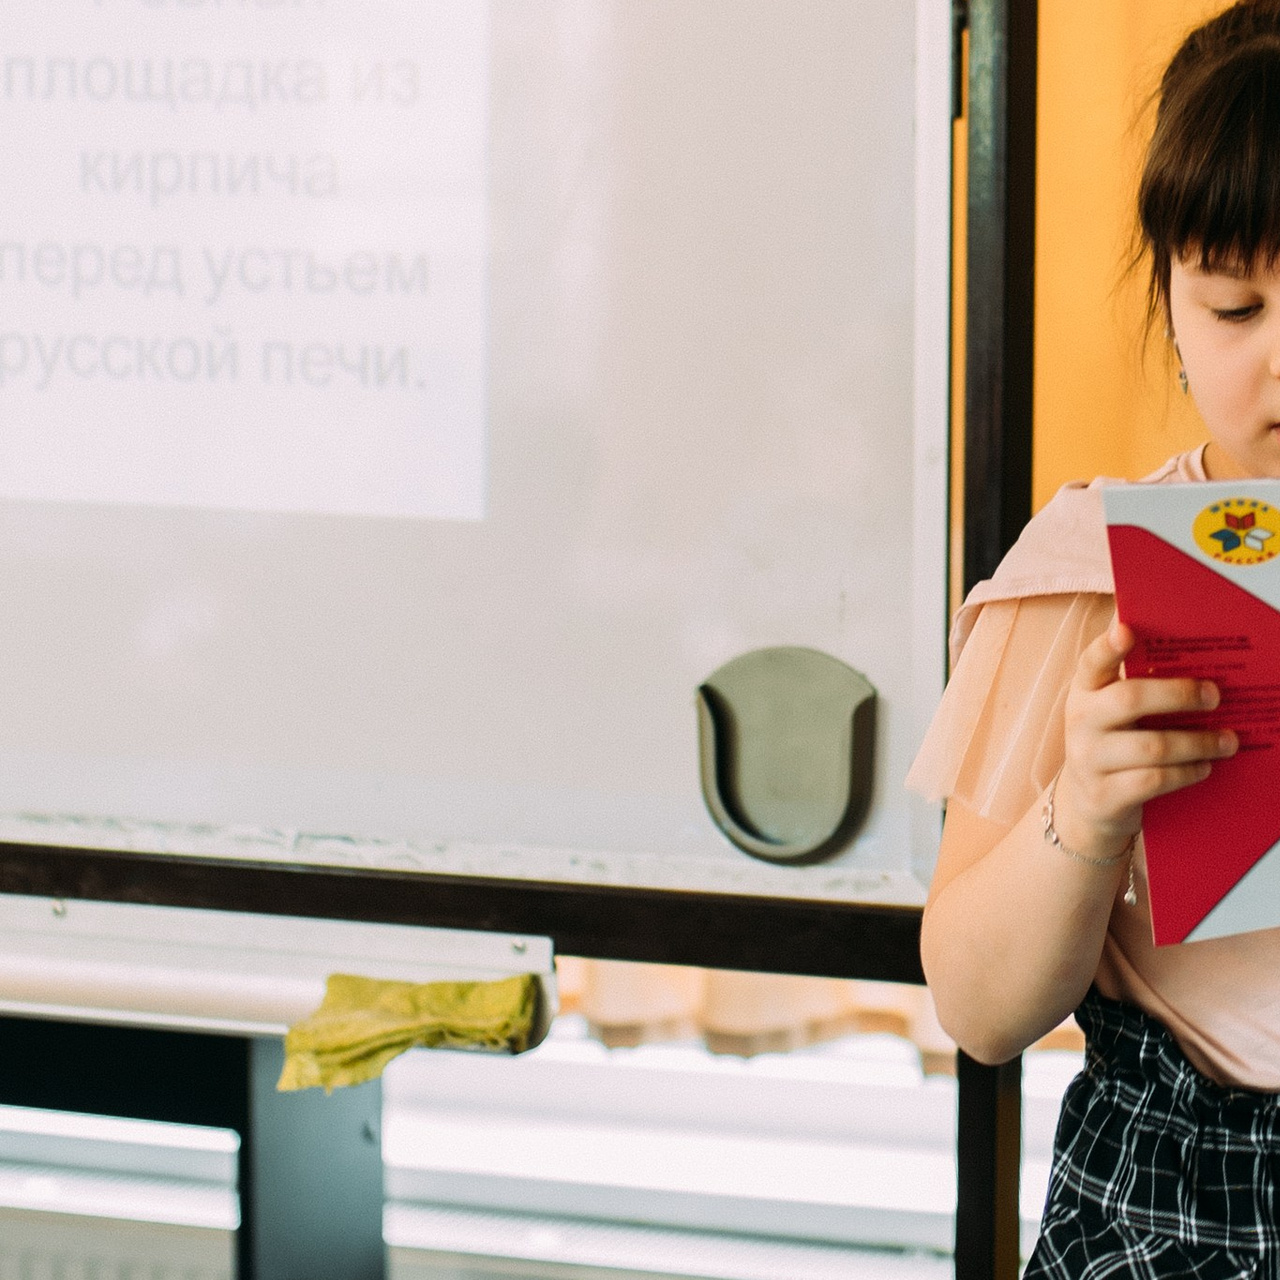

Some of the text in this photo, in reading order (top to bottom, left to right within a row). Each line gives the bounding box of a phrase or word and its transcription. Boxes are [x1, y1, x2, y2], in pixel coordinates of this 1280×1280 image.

[3, 54, 422, 113] площадка из
[78, 148, 341, 204] кирпича
[202, 247, 432, 307] устьем
[261, 338, 428, 390] печи.
